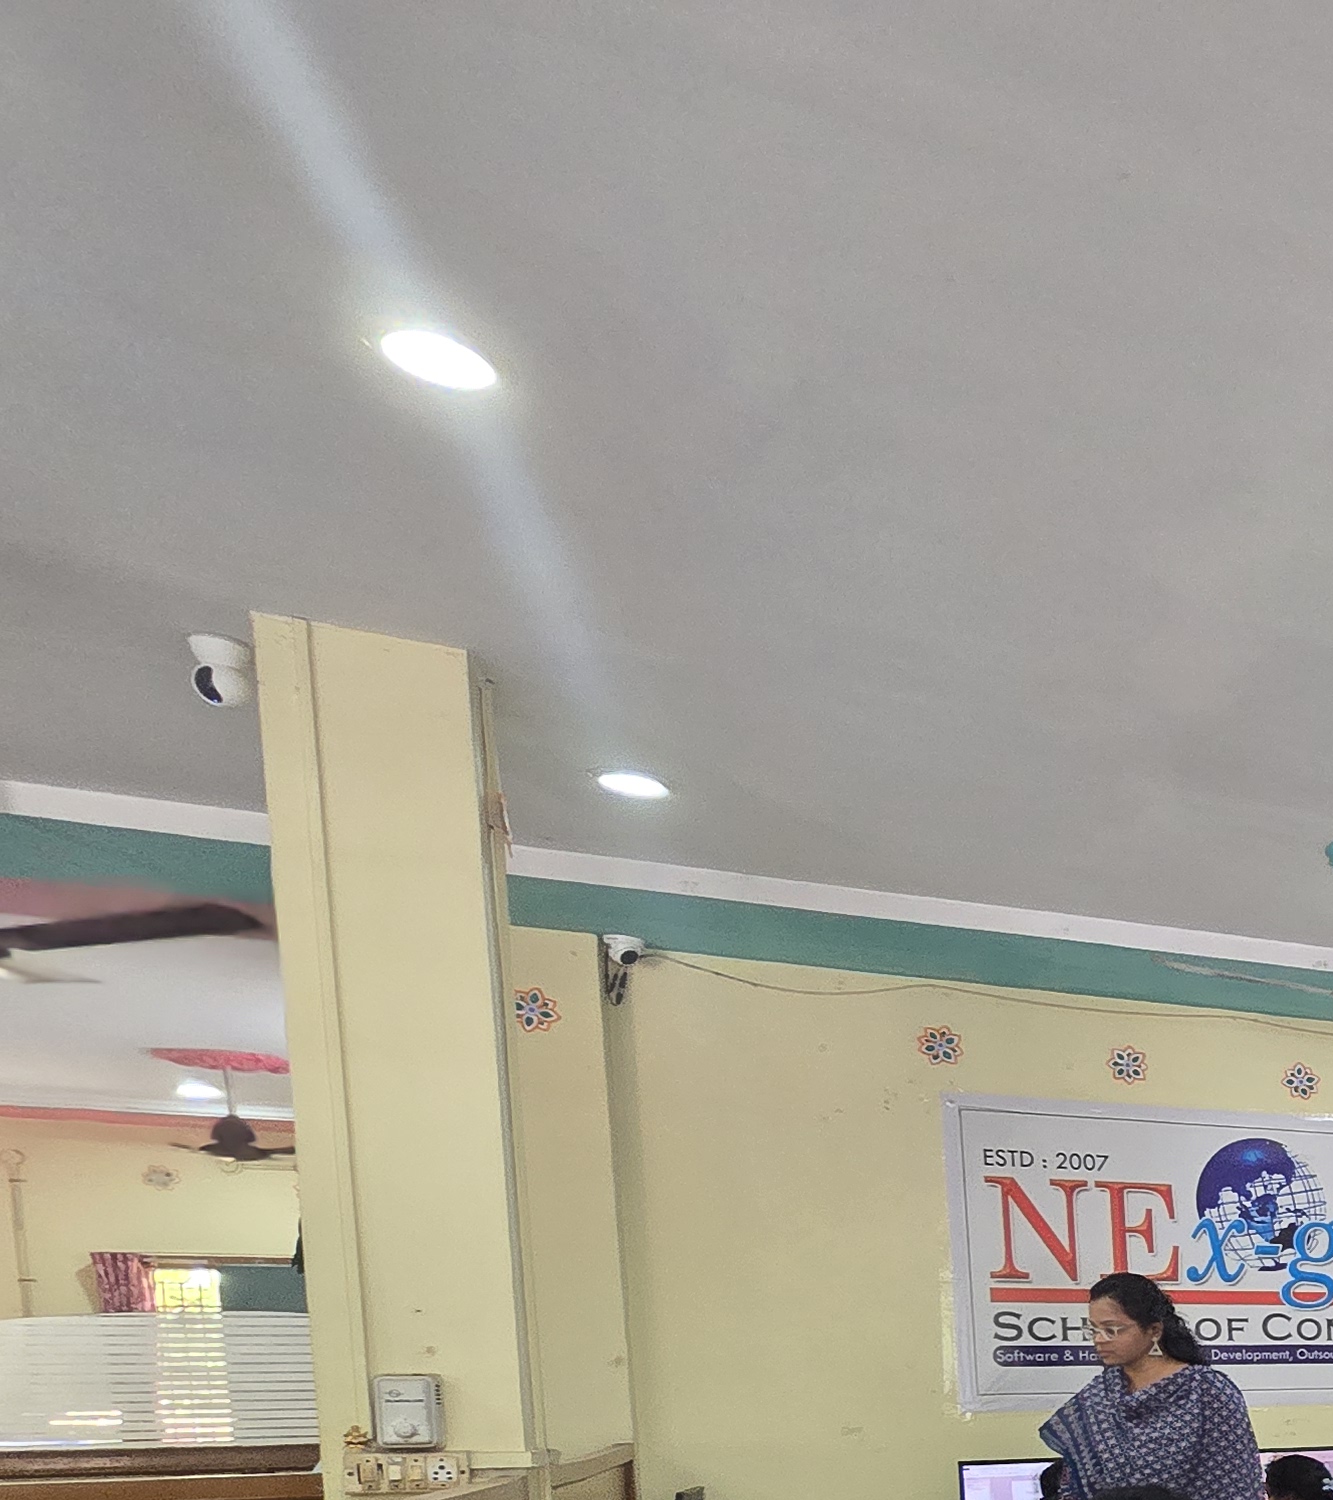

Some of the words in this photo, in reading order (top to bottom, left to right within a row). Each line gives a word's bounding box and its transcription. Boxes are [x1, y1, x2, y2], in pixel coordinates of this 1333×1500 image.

[983, 1148, 1035, 1168] ESTD
[1055, 1153, 1109, 1172] 2007
[993, 1310, 1090, 1342] SCH
[1195, 1316, 1249, 1342] OF
[996, 1349, 1046, 1363] Software
[1063, 1350, 1075, 1362] &
[1211, 1349, 1294, 1362] Development,
